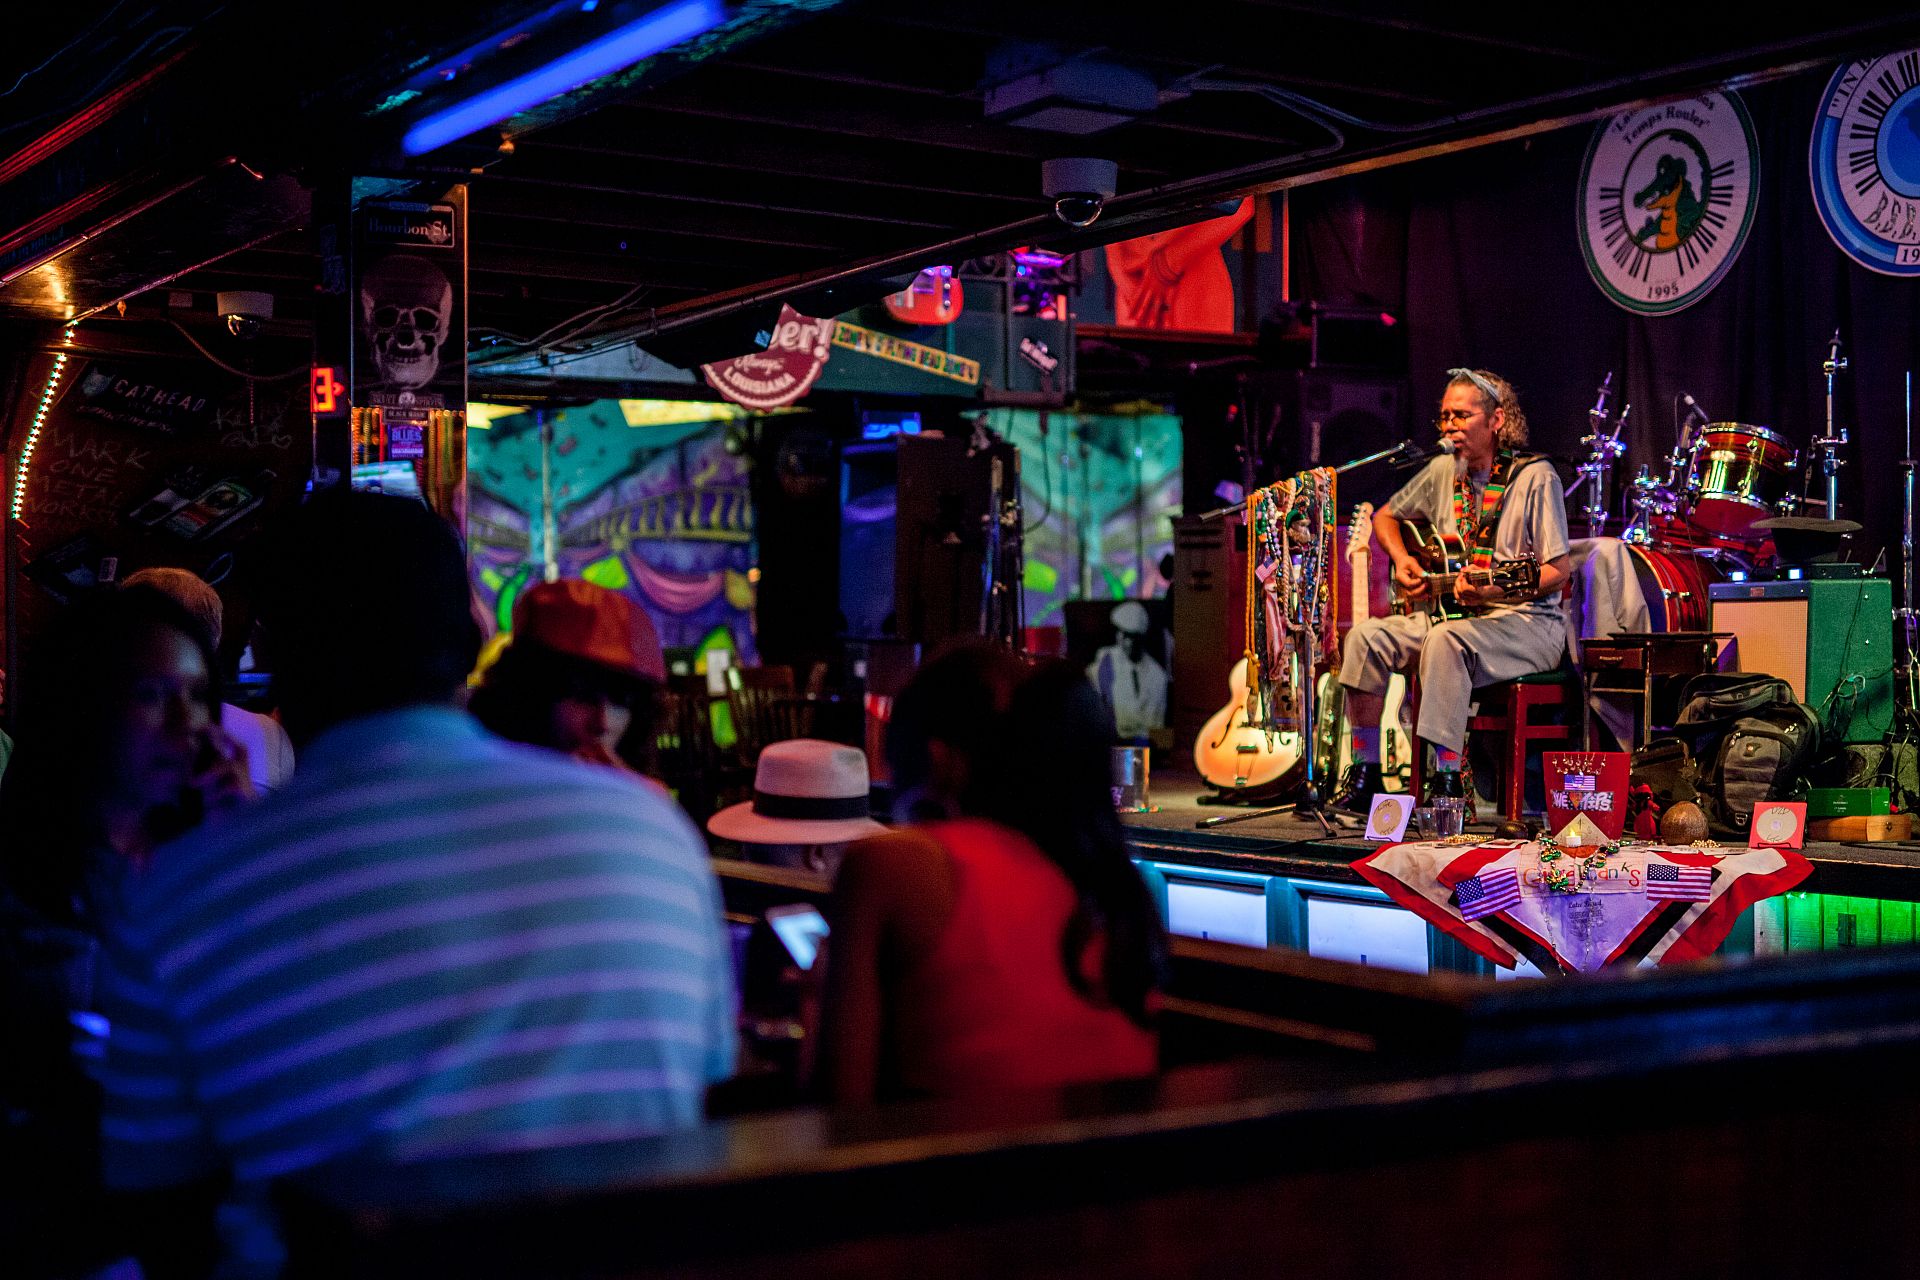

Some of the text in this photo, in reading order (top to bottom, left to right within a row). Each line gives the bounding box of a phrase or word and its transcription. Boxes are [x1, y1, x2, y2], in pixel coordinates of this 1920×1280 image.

[368, 216, 452, 237] Bourbon St.
[1648, 281, 1679, 299] 1995
[112, 379, 206, 412] CATHEAD
[50, 459, 117, 484] ONE
